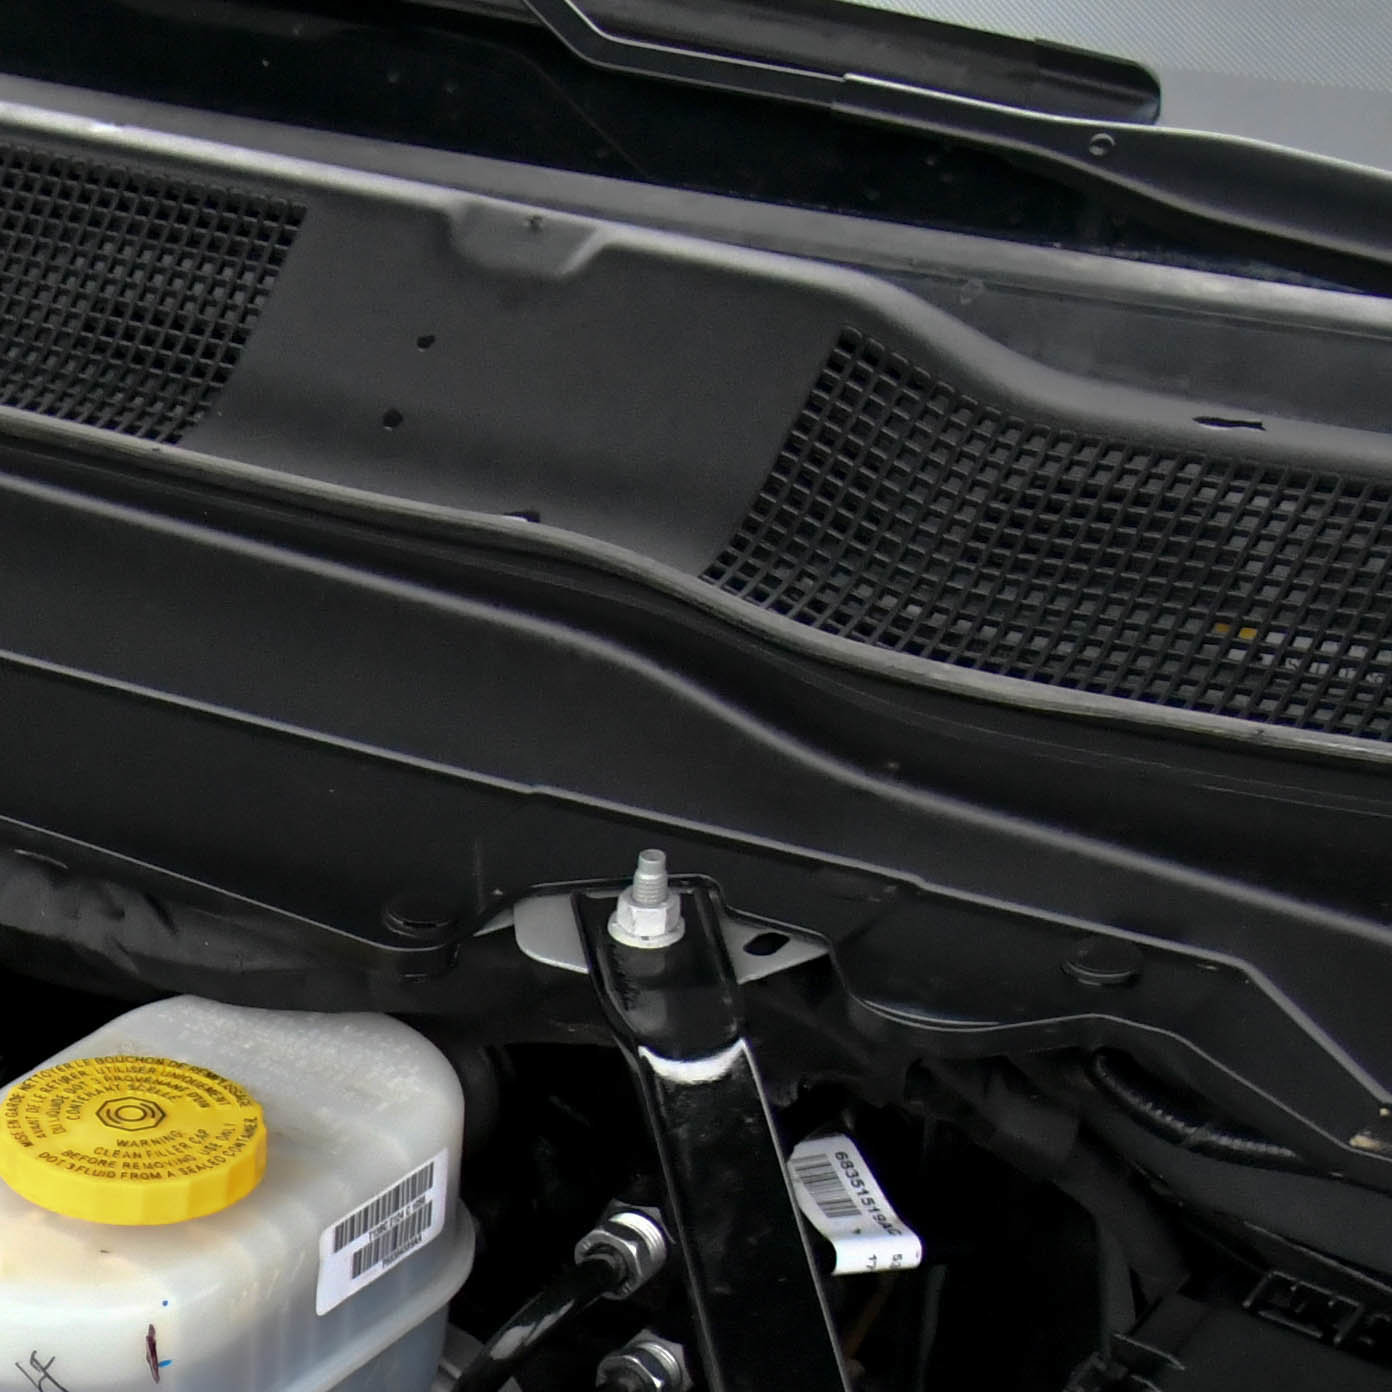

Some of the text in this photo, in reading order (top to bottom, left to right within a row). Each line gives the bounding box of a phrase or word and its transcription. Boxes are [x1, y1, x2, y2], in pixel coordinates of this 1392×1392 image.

[61, 1149, 116, 1168] BEFORE
[94, 1146, 142, 1159] CLEAN
[147, 1142, 192, 1157] FILLER
[38, 1152, 66, 1166] DOT
[75, 1165, 116, 1179] FLUID
[121, 1171, 162, 1180] FROM
